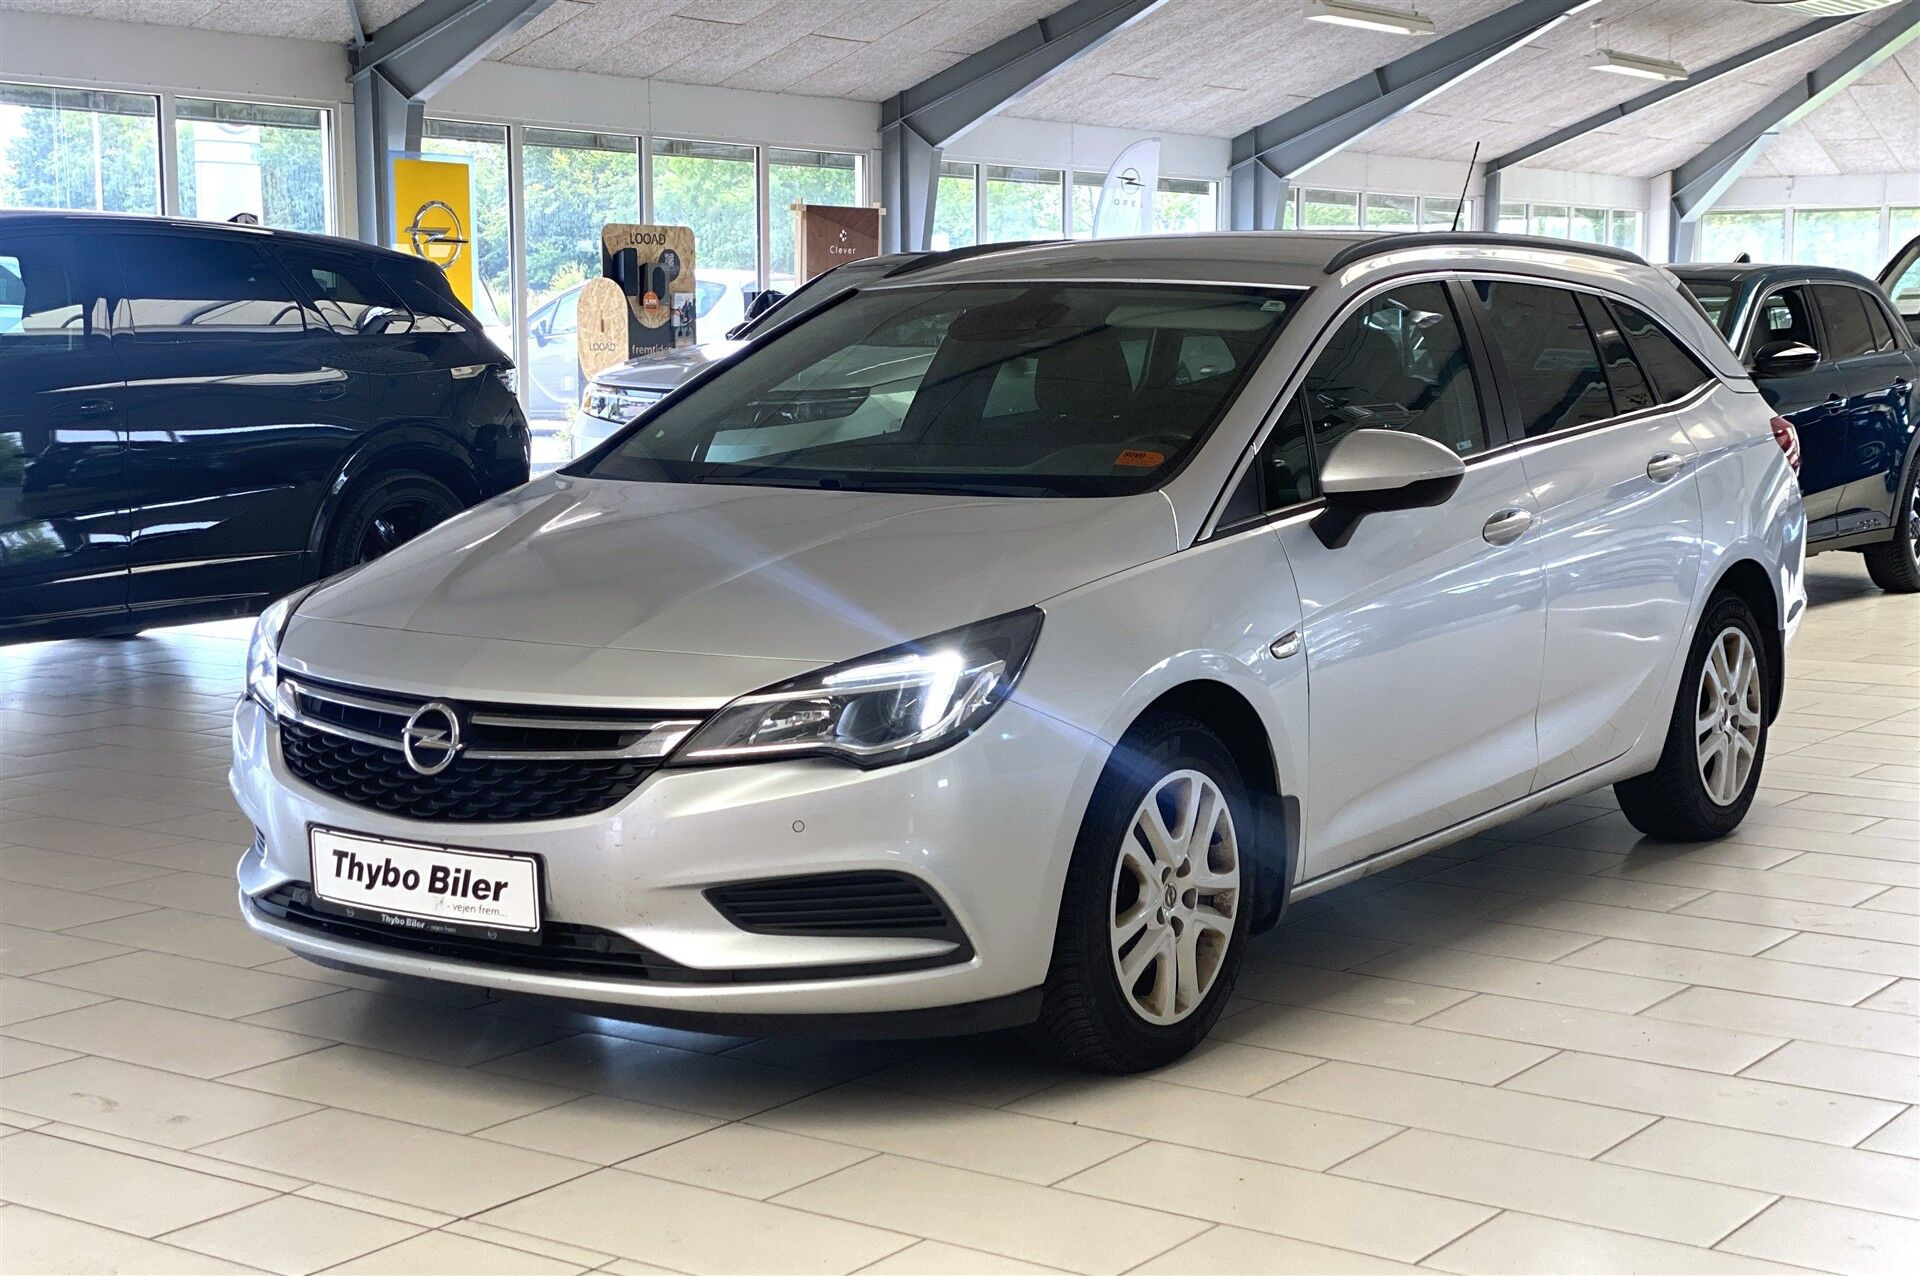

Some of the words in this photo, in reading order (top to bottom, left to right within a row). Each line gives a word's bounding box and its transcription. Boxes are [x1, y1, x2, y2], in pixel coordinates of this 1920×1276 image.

[1113, 198, 1143, 208] OPEL
[630, 232, 666, 245] LOOAD
[830, 245, 856, 254] Clever
[589, 342, 616, 352] LOOAD
[332, 848, 420, 891] Thybo
[428, 865, 508, 902] Biler
[452, 903, 476, 914] vejen
[381, 913, 405, 925] Thybo
[406, 917, 425, 928] Biler
